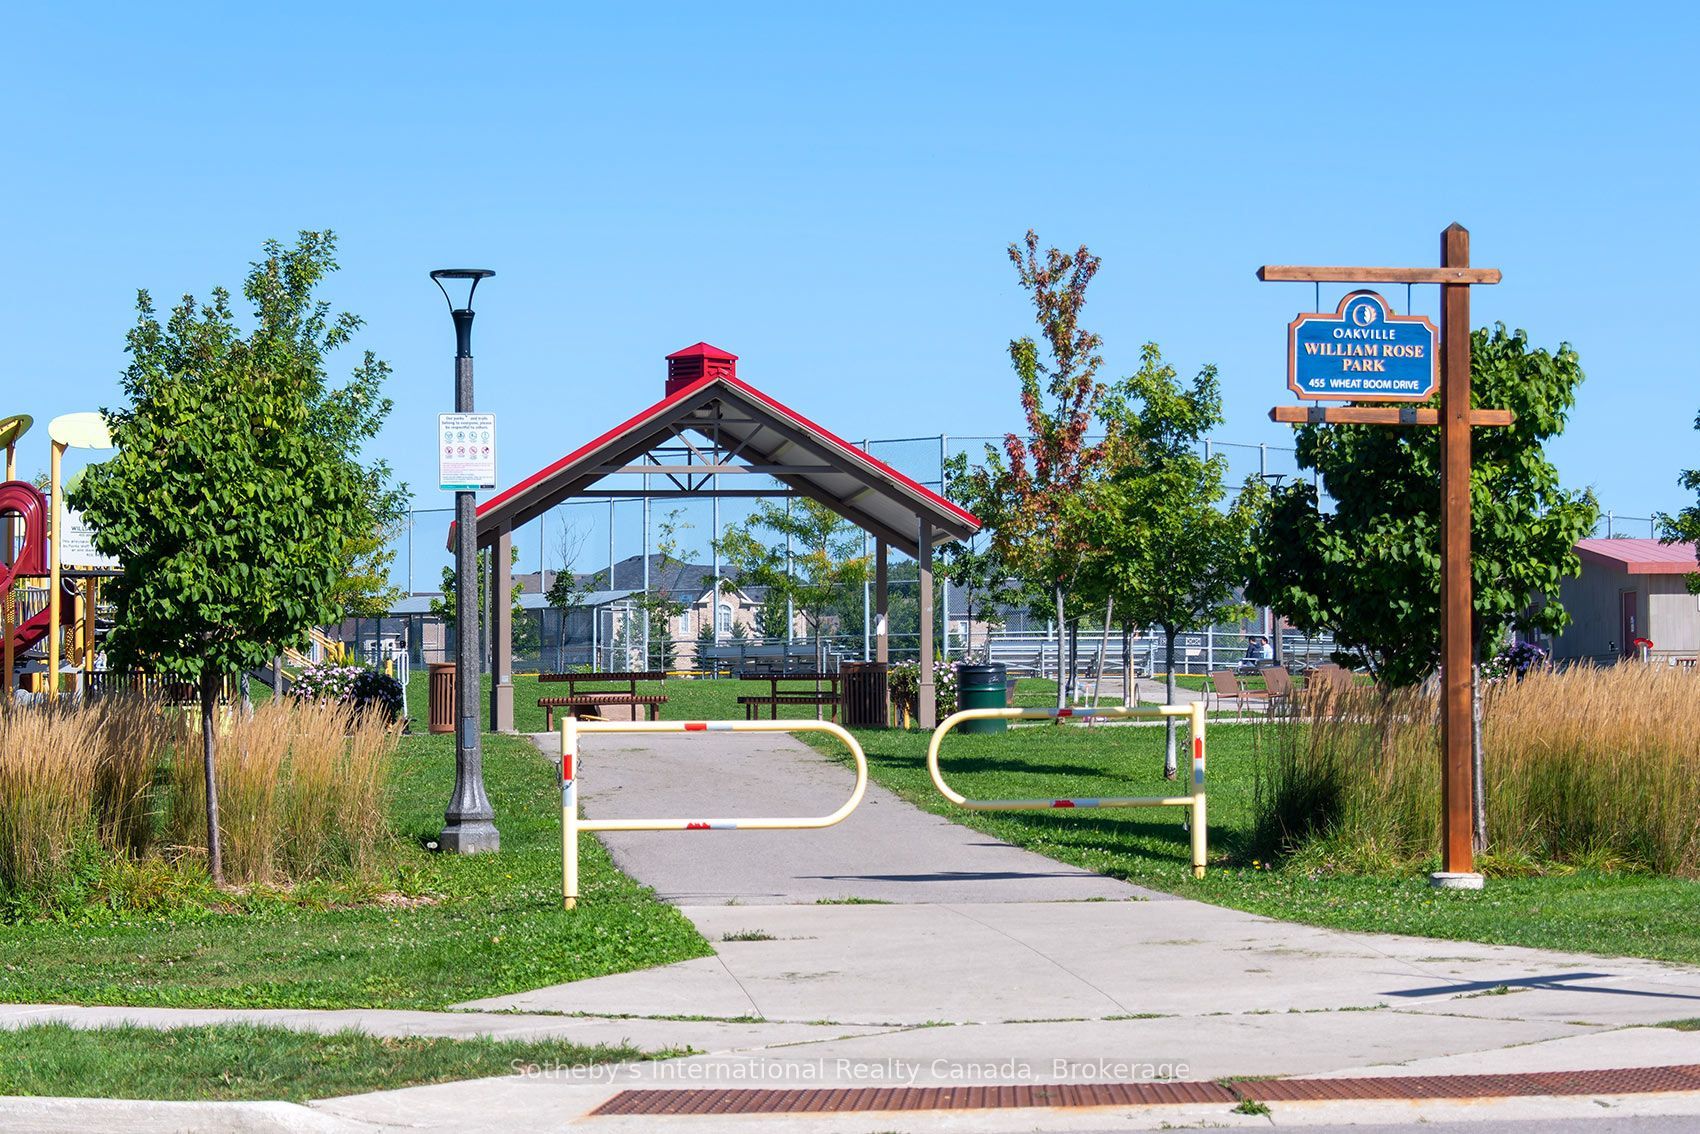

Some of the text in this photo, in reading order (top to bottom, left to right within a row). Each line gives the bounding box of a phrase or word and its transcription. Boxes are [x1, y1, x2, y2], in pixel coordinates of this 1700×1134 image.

[1333, 328, 1396, 340] OAKVILLE
[1305, 342, 1424, 358] WILLIAM ROSE
[1343, 359, 1385, 372] PARK
[1309, 378, 1419, 390] 455 WHEAT BOOM DRIVE
